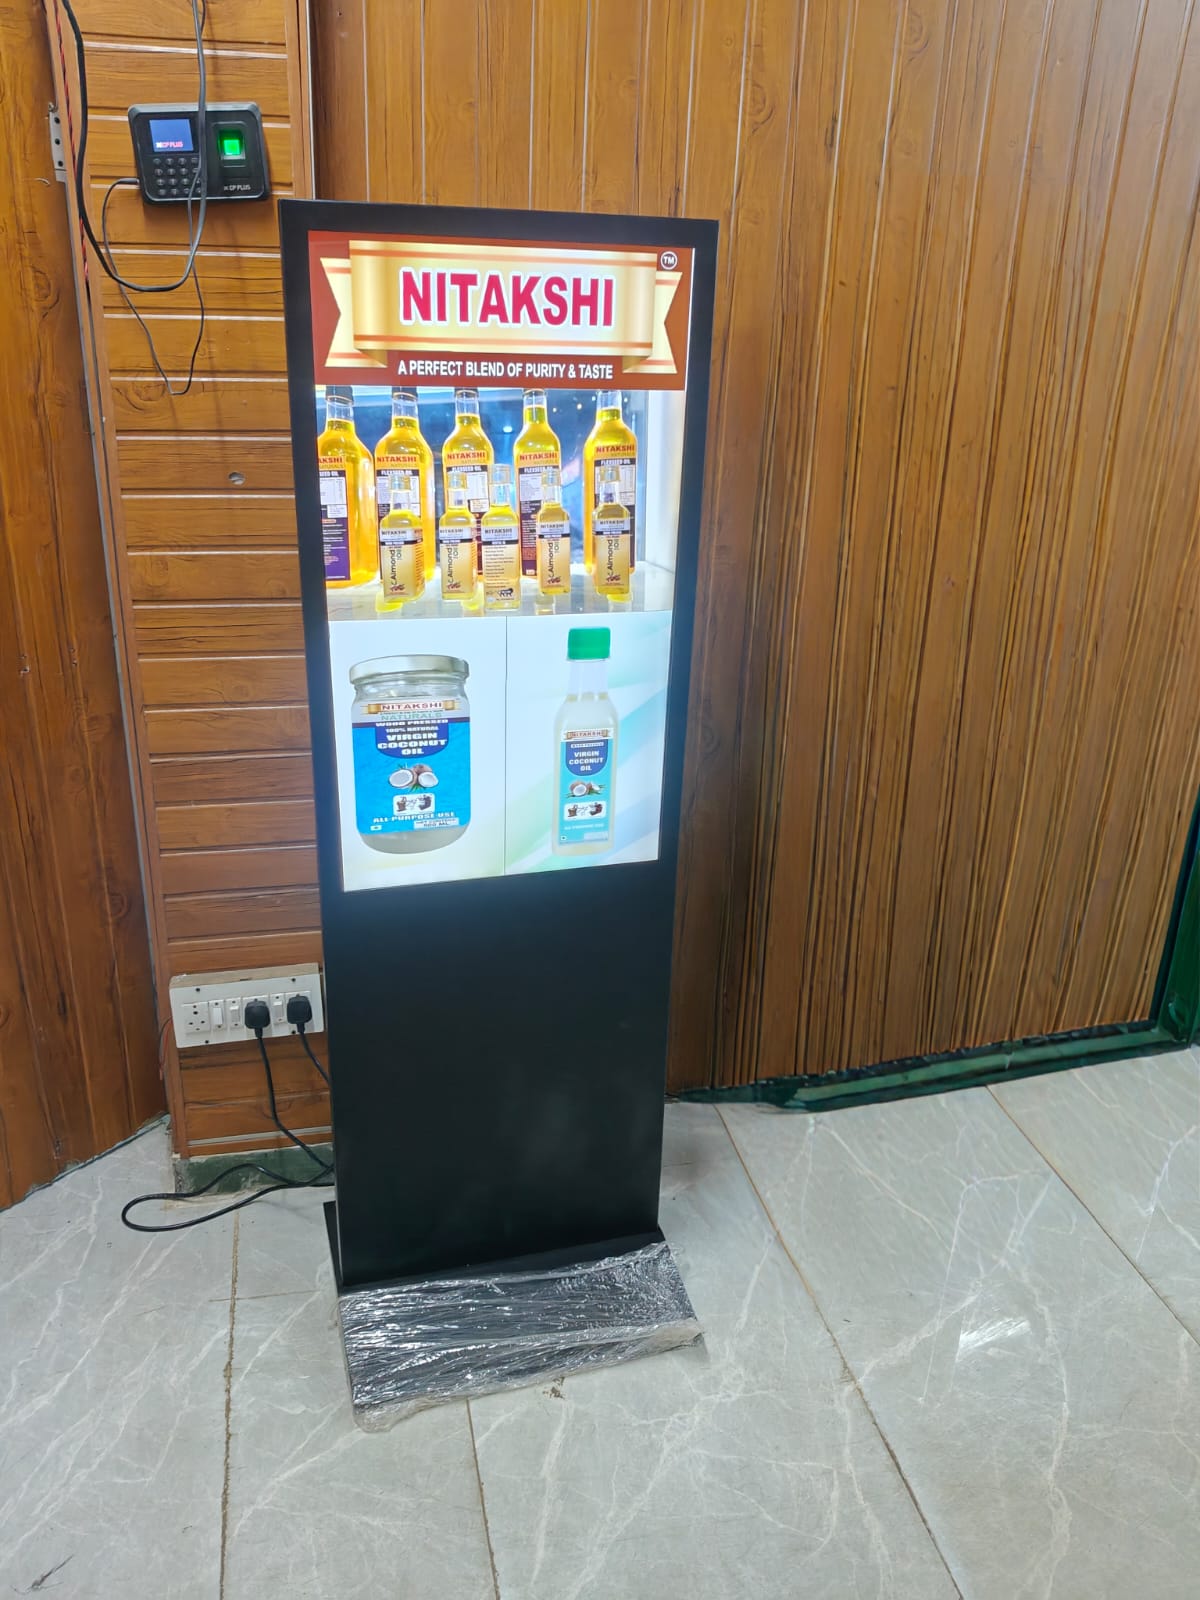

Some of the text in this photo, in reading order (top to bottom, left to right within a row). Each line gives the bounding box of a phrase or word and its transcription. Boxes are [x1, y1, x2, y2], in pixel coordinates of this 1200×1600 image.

[663, 255, 675, 265] TM
[402, 271, 614, 327] NITAKSHI
[397, 360, 613, 379] A PERFECT BLEND OF PURITY & TASTE
[596, 444, 635, 453] NITAKSHI
[447, 452, 486, 460] NITAKSHI
[519, 452, 558, 461] NITAKSHI
[382, 702, 442, 710] NITAKSHI
[381, 712, 442, 721] NATURALS
[386, 732, 438, 741] VIRGIN
[377, 739, 448, 750] COCONUT
[401, 748, 424, 756] OIL
[574, 750, 600, 758] VIRGIN
[568, 757, 604, 766] COCONUT
[391, 813, 434, 822] PURPOSE
